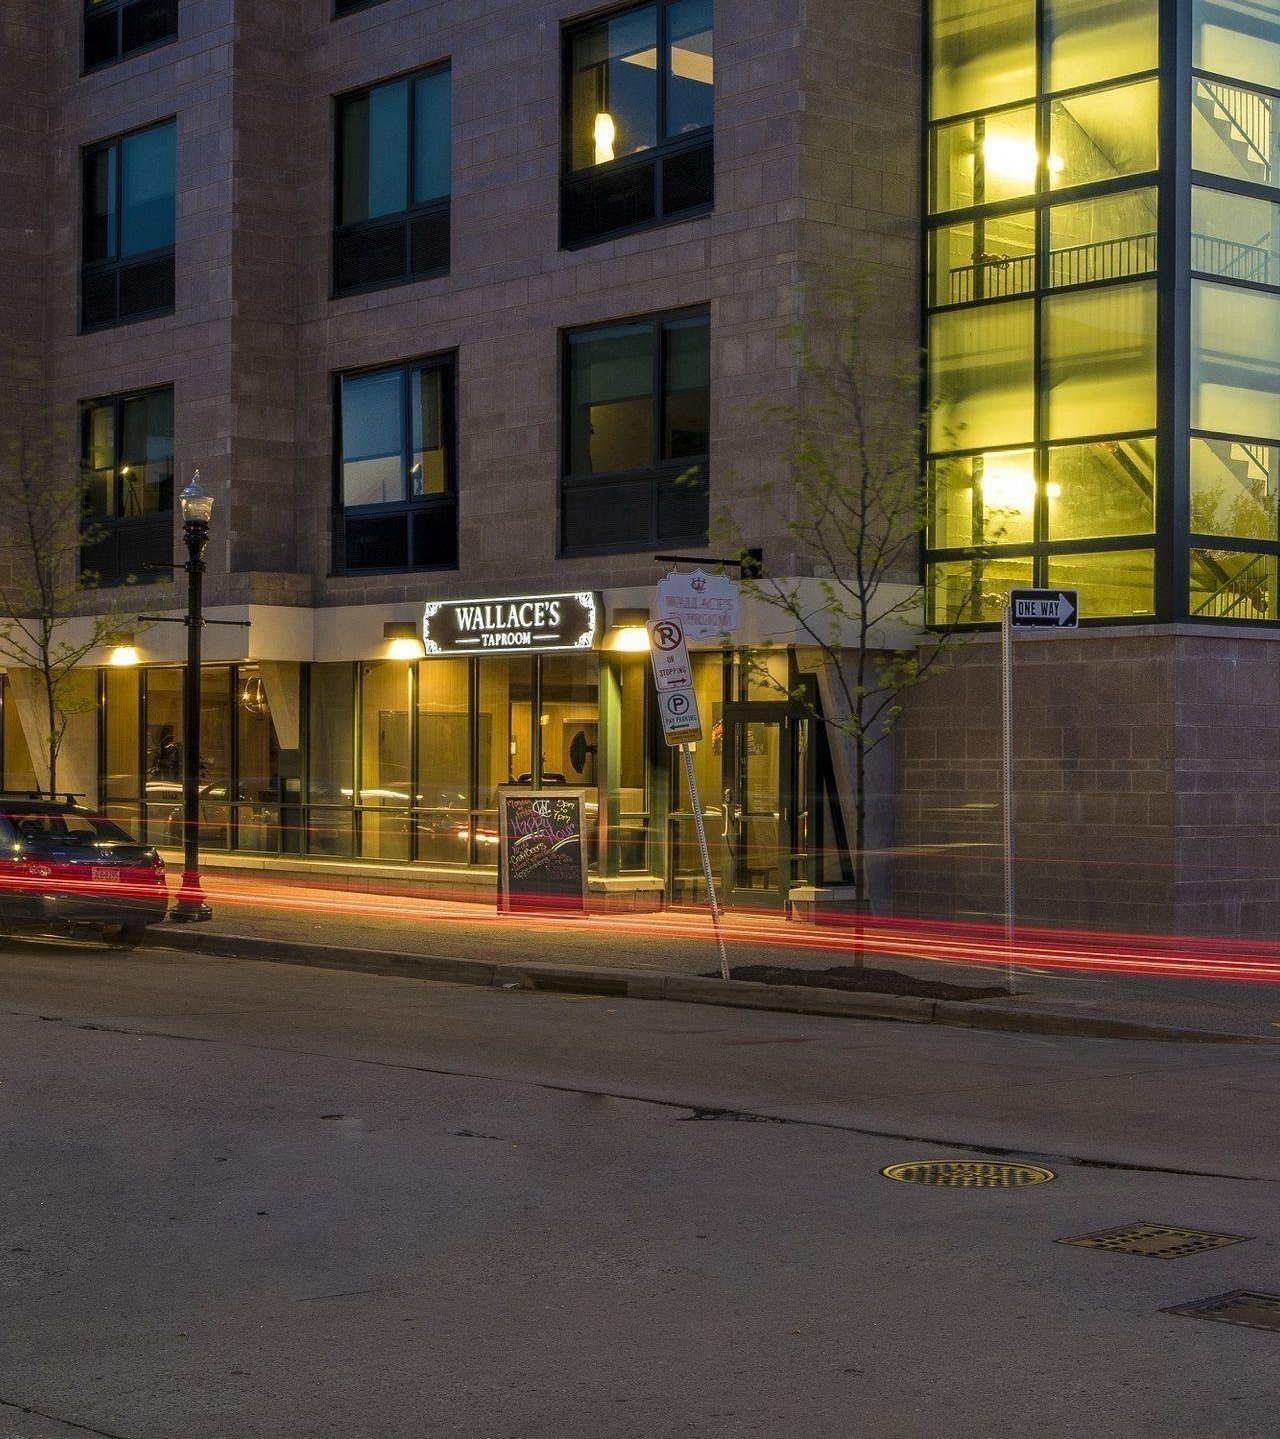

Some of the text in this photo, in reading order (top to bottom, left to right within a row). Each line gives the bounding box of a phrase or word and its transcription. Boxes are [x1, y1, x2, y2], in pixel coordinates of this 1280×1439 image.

[1018, 601, 1059, 616] ONE WAY
[455, 601, 561, 631] WALLACE'S
[481, 632, 531, 647] TAPROOM
[660, 667, 687, 677] STOPPING
[673, 698, 684, 711] P
[676, 714, 697, 722] PARKING
